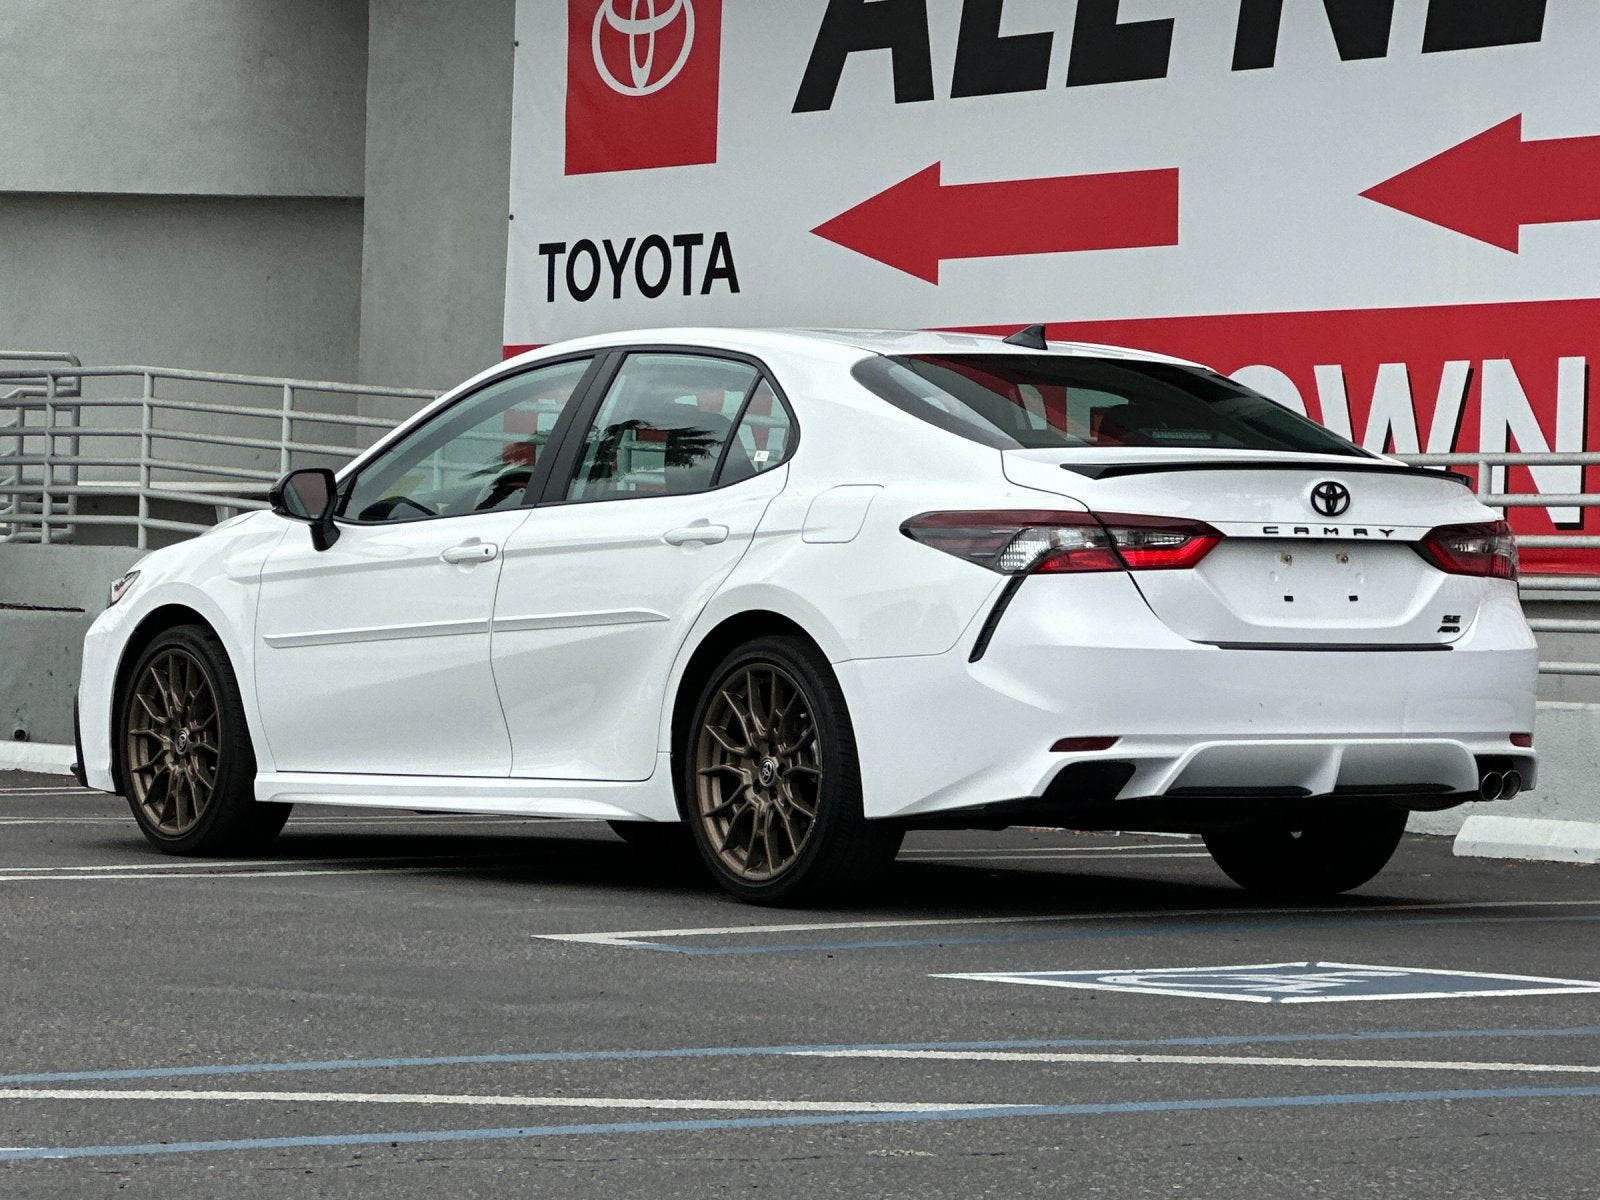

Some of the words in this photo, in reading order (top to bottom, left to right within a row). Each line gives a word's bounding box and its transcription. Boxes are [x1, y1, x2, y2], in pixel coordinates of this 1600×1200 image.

[538, 231, 740, 303] TOYOTA
[1262, 525, 1395, 539] CAMRY
[1441, 614, 1462, 624] SE
